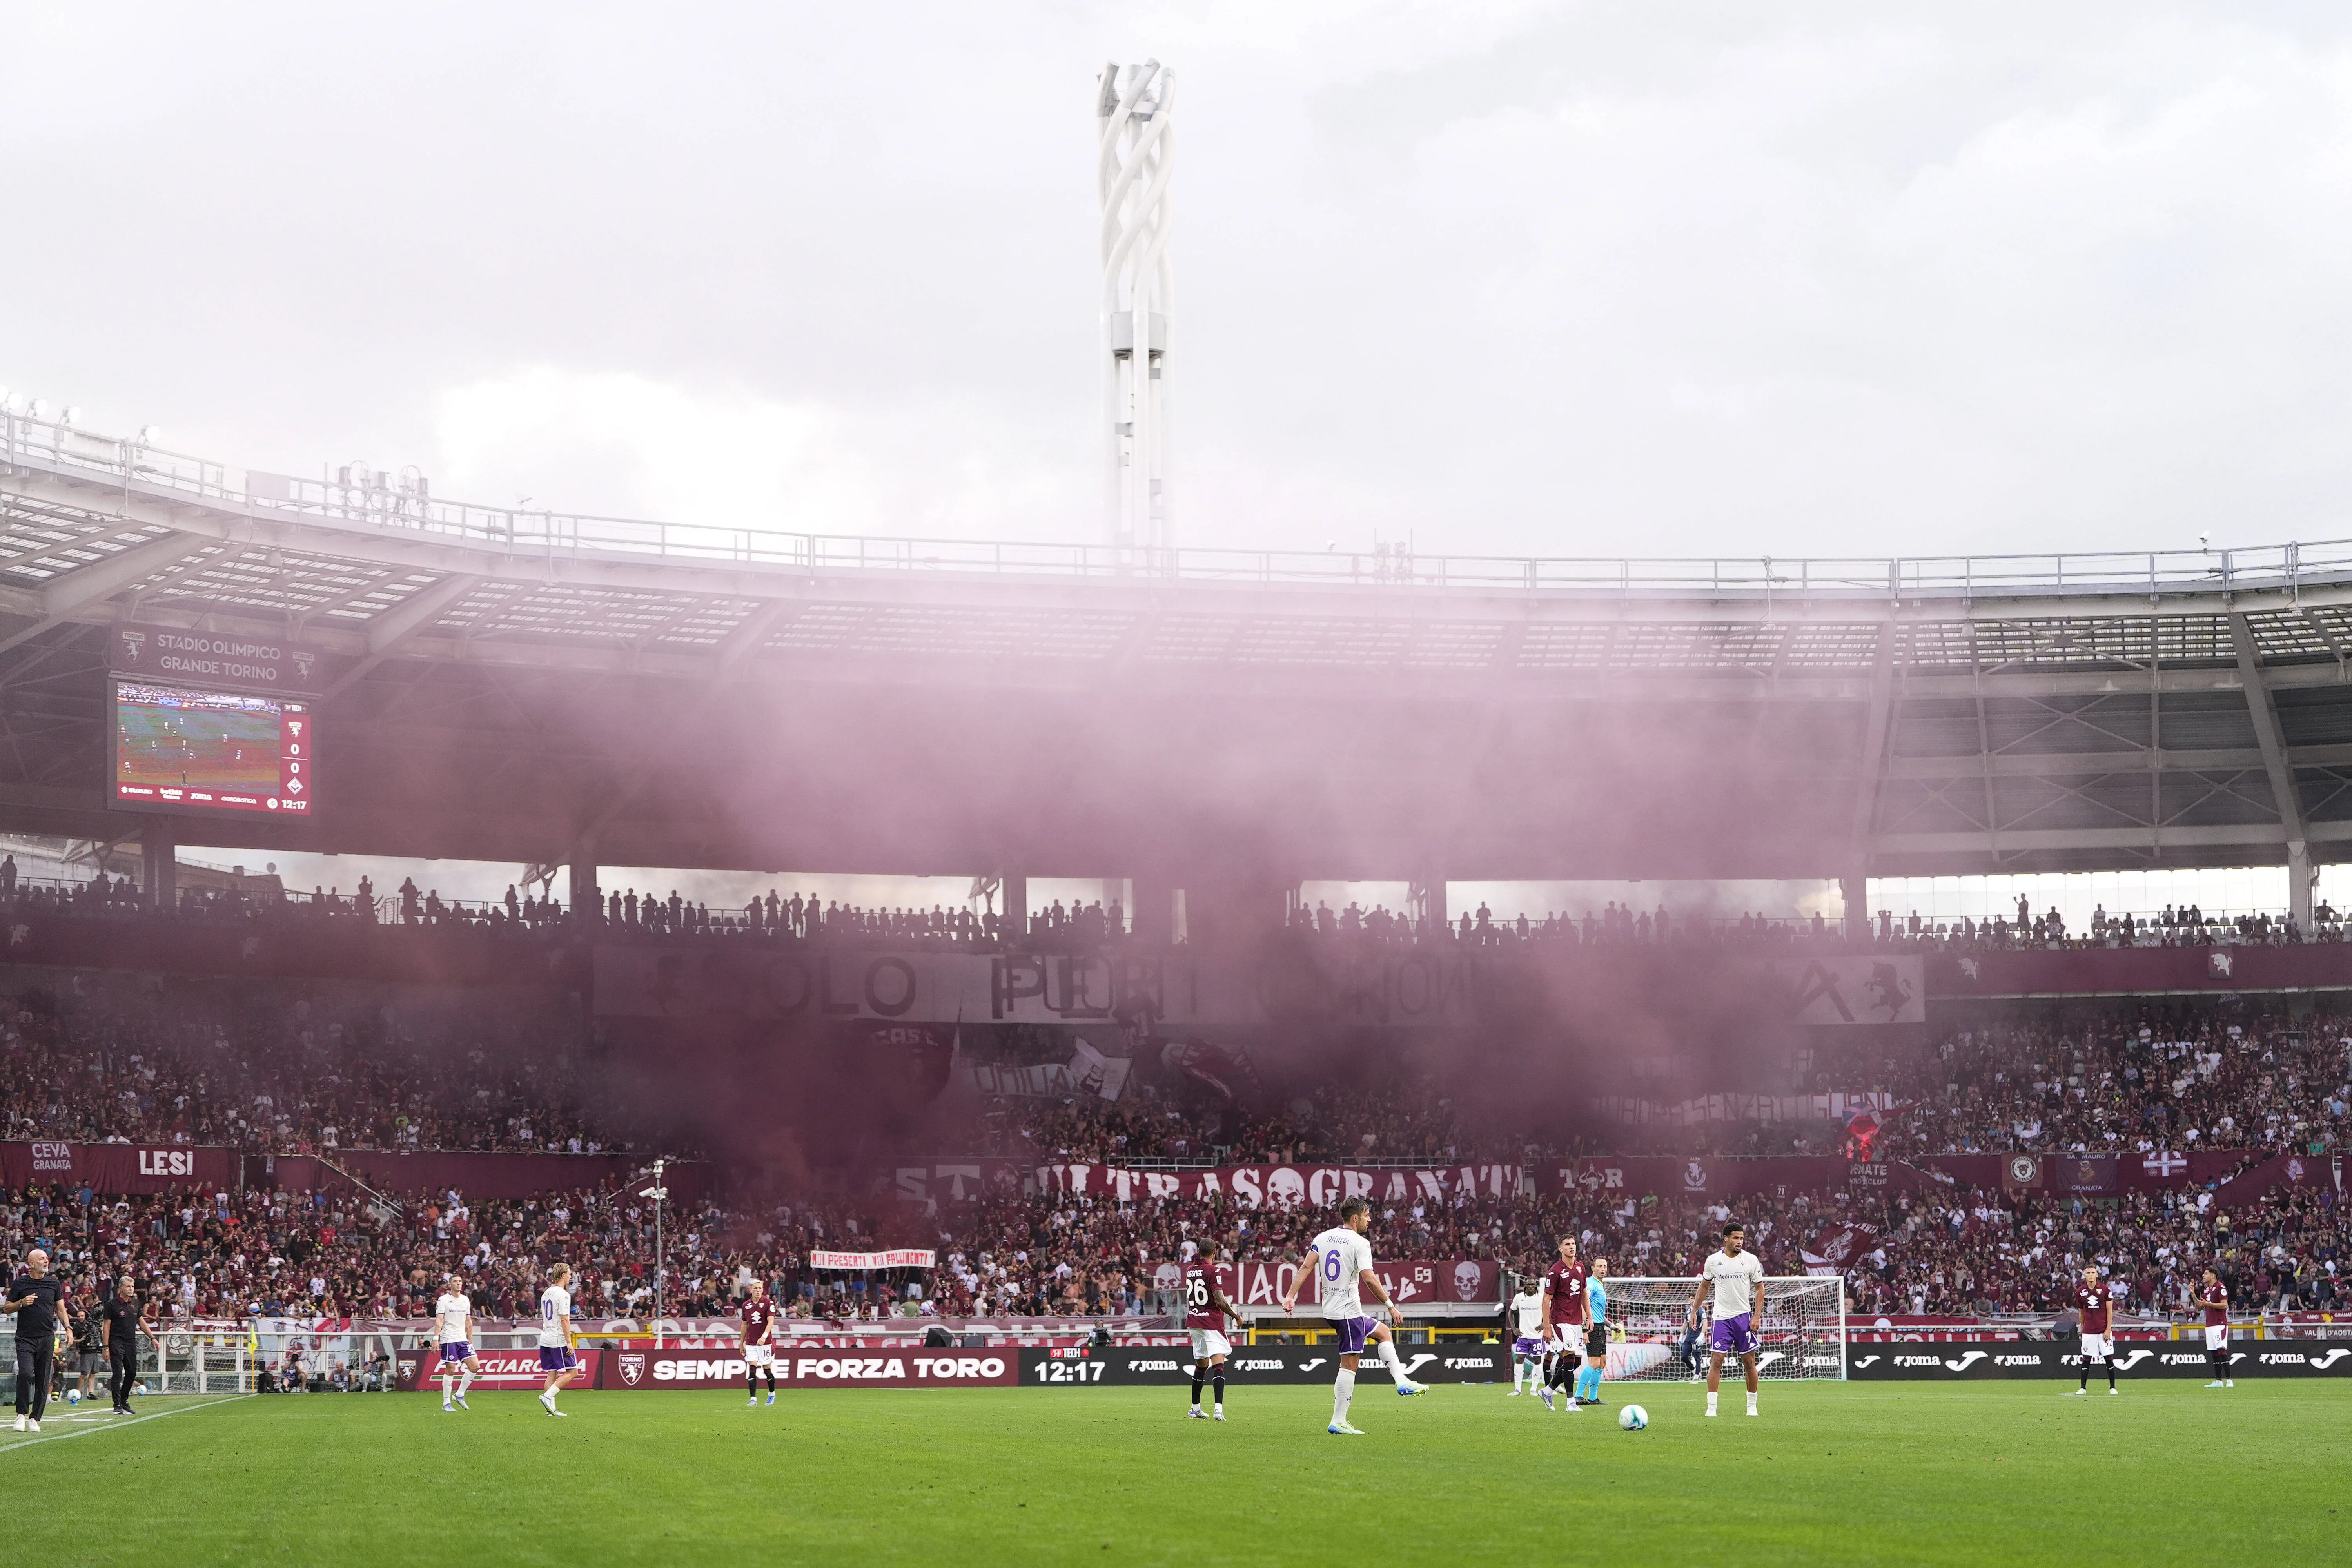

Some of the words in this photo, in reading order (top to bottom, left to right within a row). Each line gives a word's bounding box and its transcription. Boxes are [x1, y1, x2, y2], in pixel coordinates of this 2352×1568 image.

[158, 634, 210, 652] STADIO
[213, 641, 281, 660] OLIMPICO
[160, 656, 219, 674] GRANDE
[222, 662, 276, 680] TORINO
[290, 744, 299, 755] 0
[290, 762, 299, 773] 0
[282, 800, 307, 810] 12:17
[32, 1143, 71, 1158] CEVA
[33, 1160, 71, 1170] GRANATA
[139, 1150, 193, 1176] LESI
[1327, 1236, 1349, 1245] RANIERI
[812, 1253, 824, 1265] NOI
[828, 1254, 866, 1267] PRESENTI
[872, 1255, 884, 1266] VOI
[886, 1252, 927, 1265] FALLIMENTI
[1325, 1249, 1340, 1281] 6
[1414, 1267, 1432, 1283] 69
[1186, 1278, 1208, 1306] 26
[542, 1299, 553, 1321] 10
[1745, 1331, 1751, 1343] 7
[1533, 1343, 1542, 1352] 20
[796, 1358, 906, 1379] FORZA
[913, 1357, 1005, 1378] TORO
[1034, 1361, 1106, 1381] 12:17
